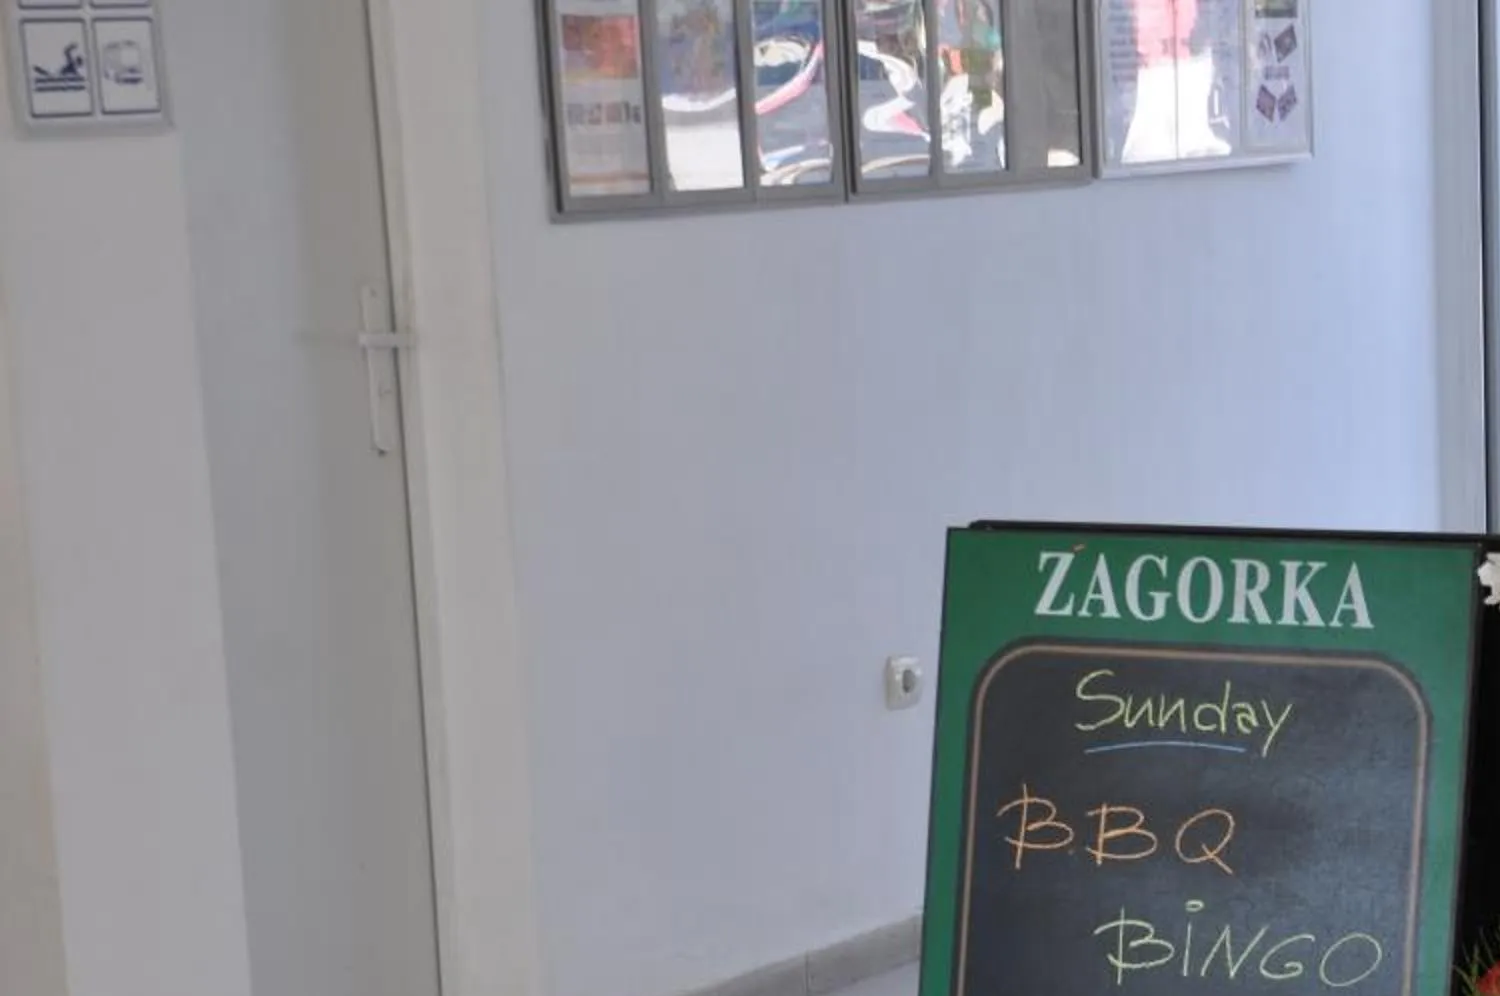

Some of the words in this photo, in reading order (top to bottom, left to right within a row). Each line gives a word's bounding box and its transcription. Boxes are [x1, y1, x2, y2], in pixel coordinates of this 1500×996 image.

[1034, 550, 1374, 630] ZAGORKA
[1074, 669, 1292, 756] Sunday
[996, 783, 1236, 875] BBQ
